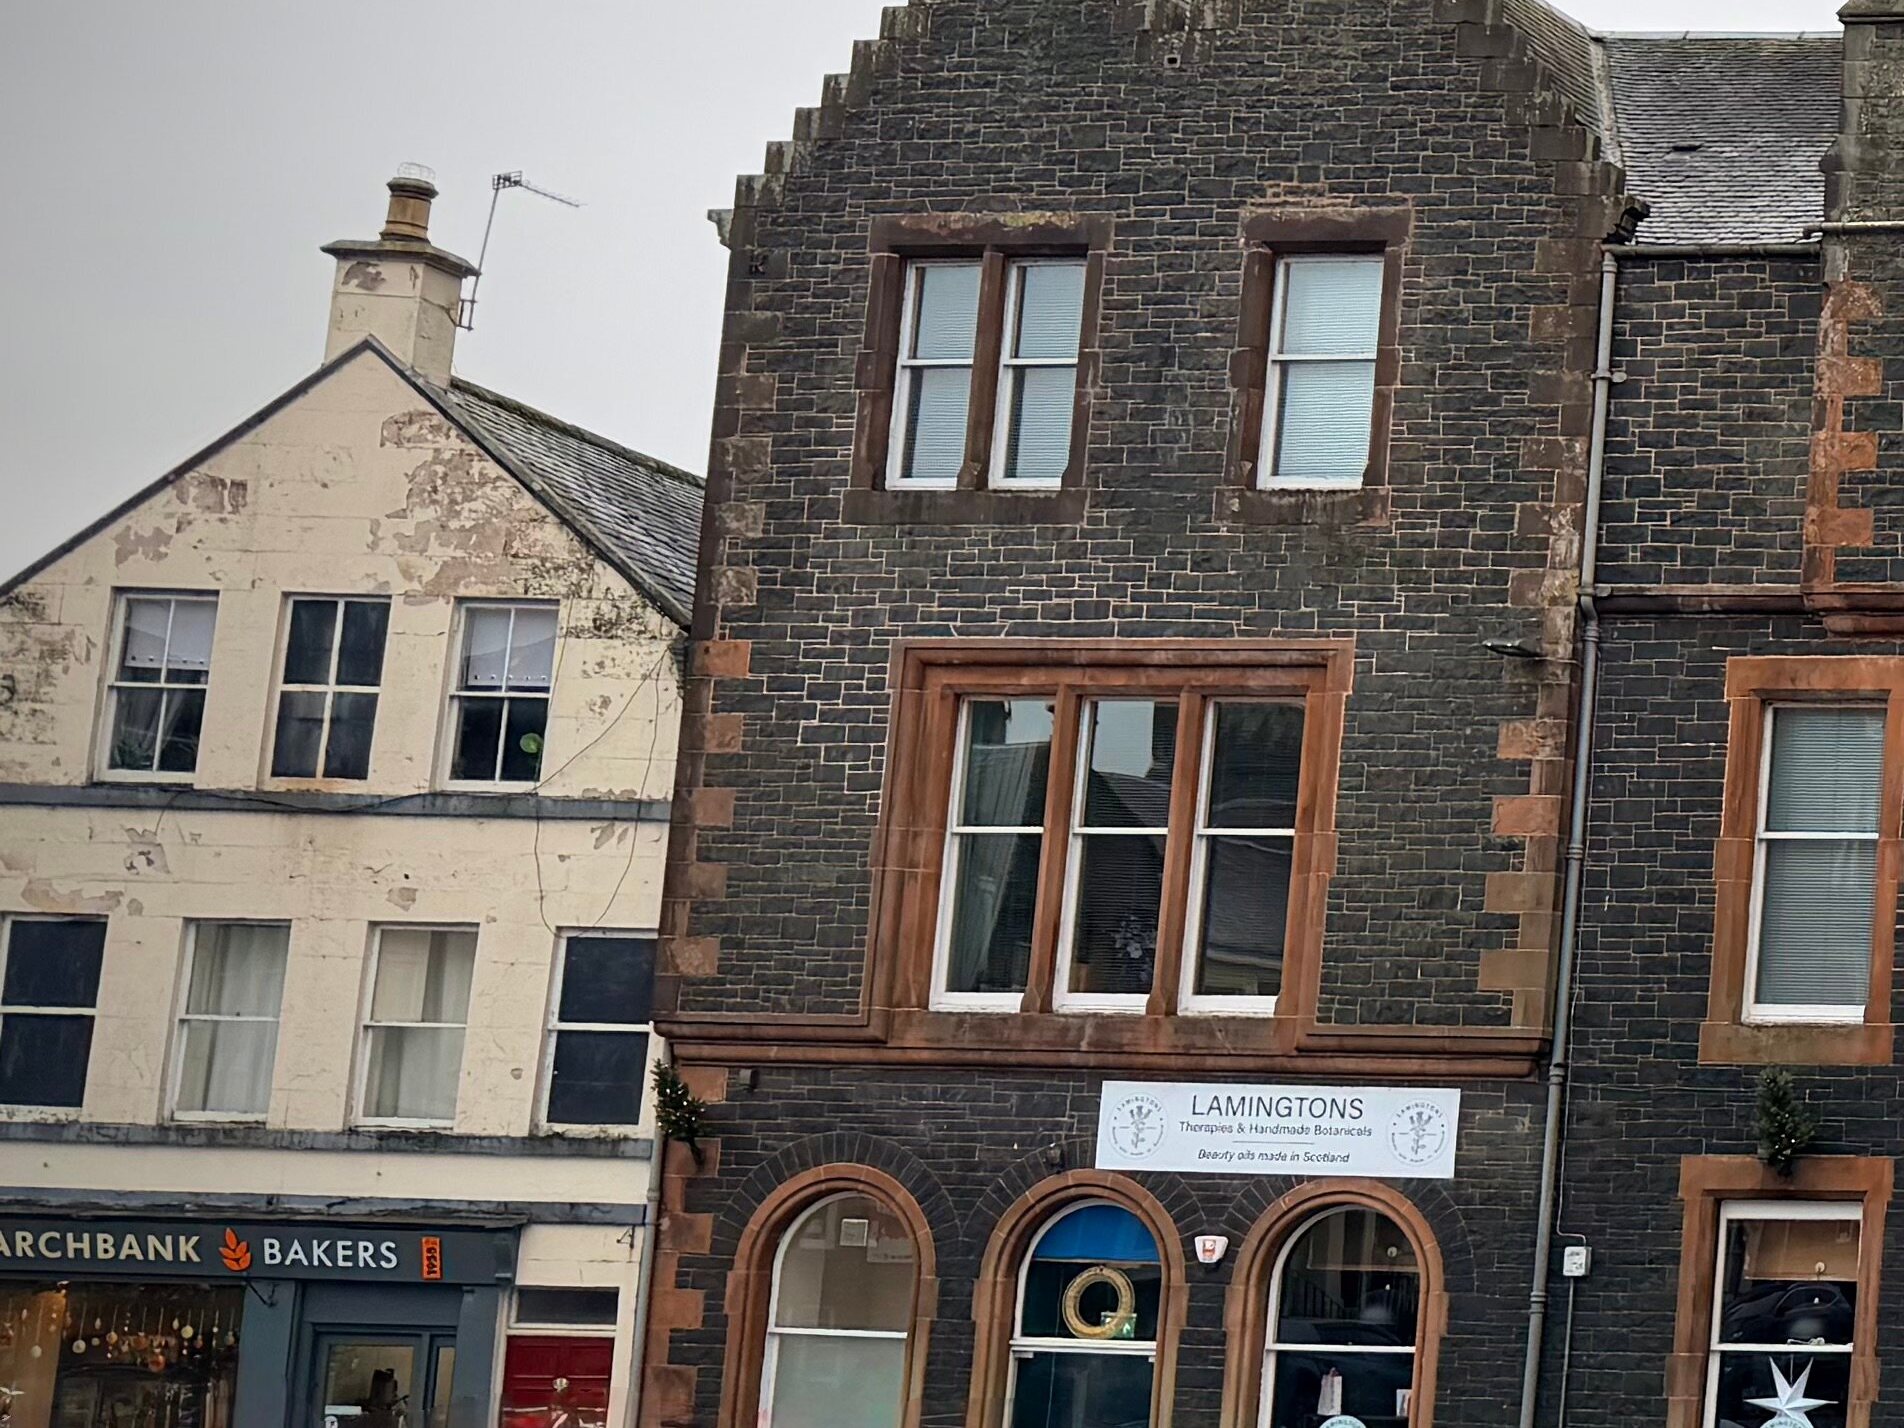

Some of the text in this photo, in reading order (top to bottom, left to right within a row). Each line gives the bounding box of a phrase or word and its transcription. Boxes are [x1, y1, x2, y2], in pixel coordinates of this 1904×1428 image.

[1192, 1094, 1363, 1120] LAMINGTONS
[1179, 1121, 1372, 1137] Therapies & Handmade Botanicals
[1198, 1148, 1235, 1162] Beauty
[1258, 1151, 1288, 1162] made
[1290, 1151, 1299, 1161] in
[1303, 1152, 1351, 1163] Scotland
[263, 1237, 398, 1269] BAKERS
